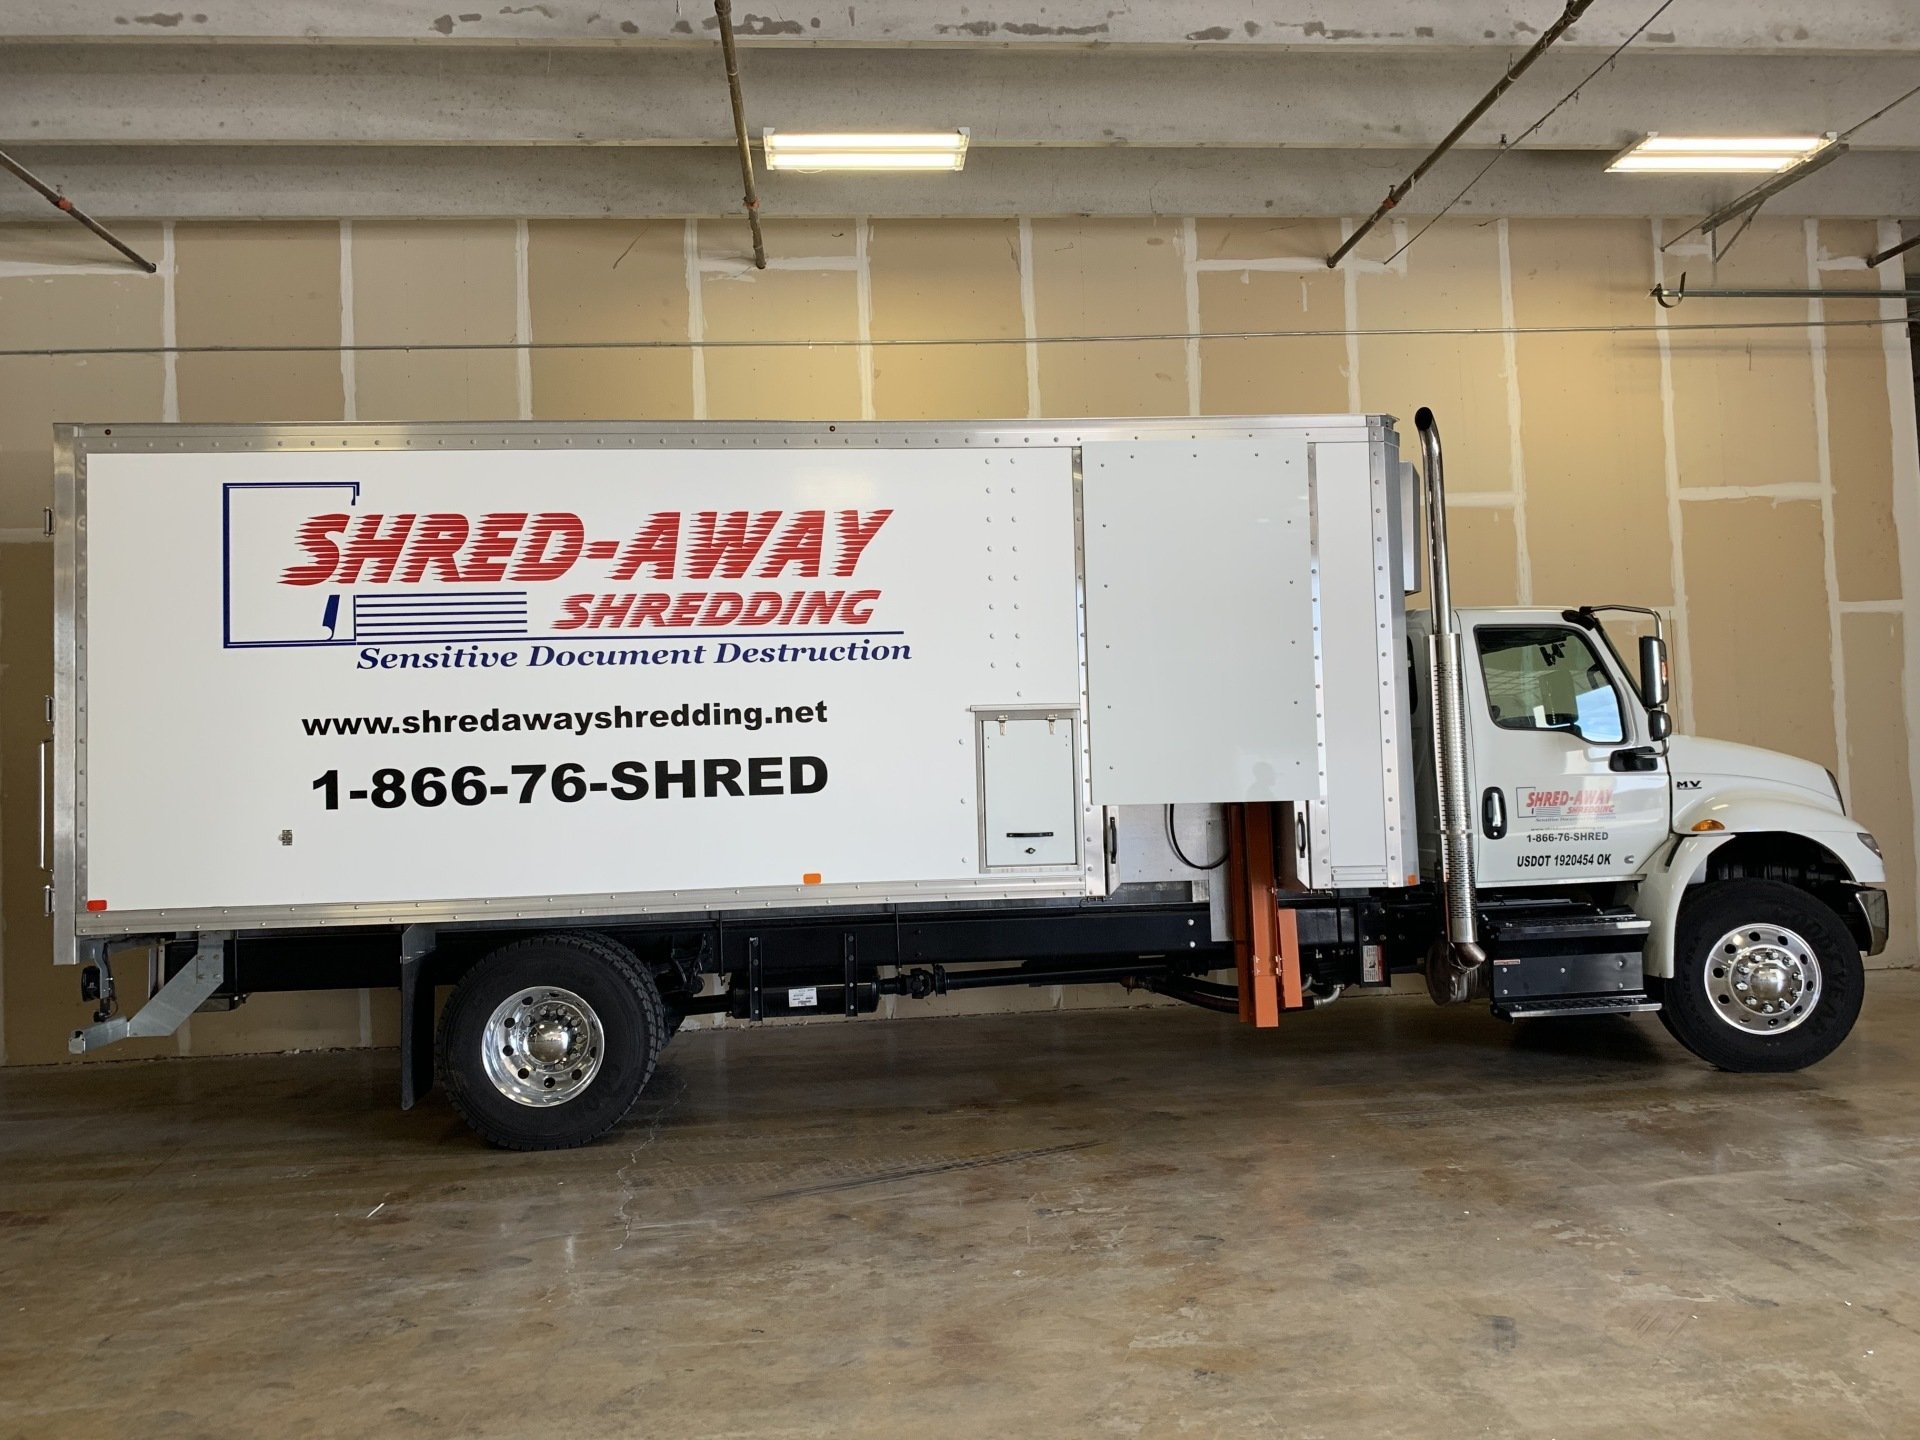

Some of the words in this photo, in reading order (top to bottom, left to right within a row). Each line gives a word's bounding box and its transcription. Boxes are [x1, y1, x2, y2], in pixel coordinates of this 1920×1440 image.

[277, 509, 893, 586] SHRED-AWAY
[551, 590, 881, 630] SHREDDING
[356, 645, 519, 670] Sensitive
[526, 642, 707, 667] Document
[713, 638, 912, 663] Destruction
[302, 700, 828, 736] www.shredawayshredding.net
[312, 756, 828, 811] 1-866-76-SHRED
[1526, 789, 1614, 808] SHRED-AWAY
[1676, 780, 1702, 788] MV
[1526, 831, 1609, 843] 1-866-76-SHRED
[1517, 855, 1551, 867] USDOT
[1554, 853, 1594, 866] 1920454
[1596, 853, 1612, 865] OK
